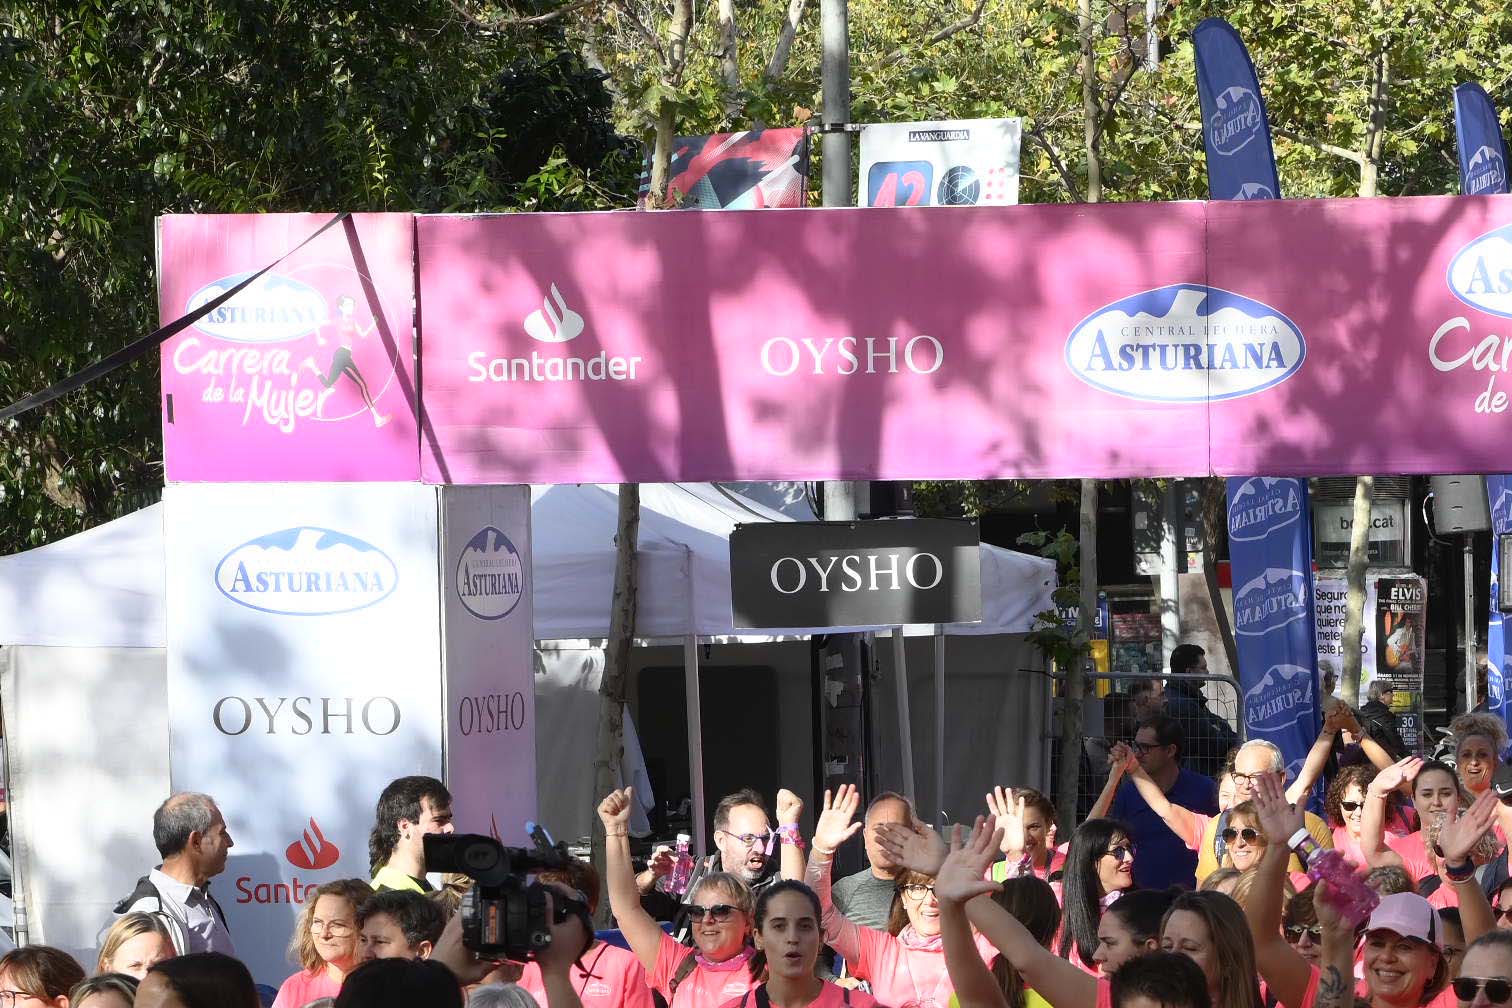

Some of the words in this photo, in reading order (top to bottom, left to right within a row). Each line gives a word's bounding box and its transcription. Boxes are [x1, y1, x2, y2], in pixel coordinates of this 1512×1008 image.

[1120, 325, 1196, 336] CENTRAL
[173, 338, 296, 375] Carrera
[467, 350, 643, 383] Santander
[760, 335, 945, 376] OYSHO
[1084, 327, 1288, 371] ASTURIANA
[202, 377, 223, 403] de
[229, 377, 245, 403] la
[243, 374, 336, 433] Mujer
[1474, 375, 1508, 414] de
[230, 561, 385, 593] ASTURIANA
[461, 564, 521, 597] ASTURIANA
[769, 552, 944, 595] OYSHO
[1316, 604, 1333, 616] que
[1390, 587, 1421, 600] ELVIS
[1318, 645, 1337, 654] este
[212, 696, 402, 736] OYSHO
[459, 691, 525, 737] OYSHO
[1401, 717, 1414, 728] 30
